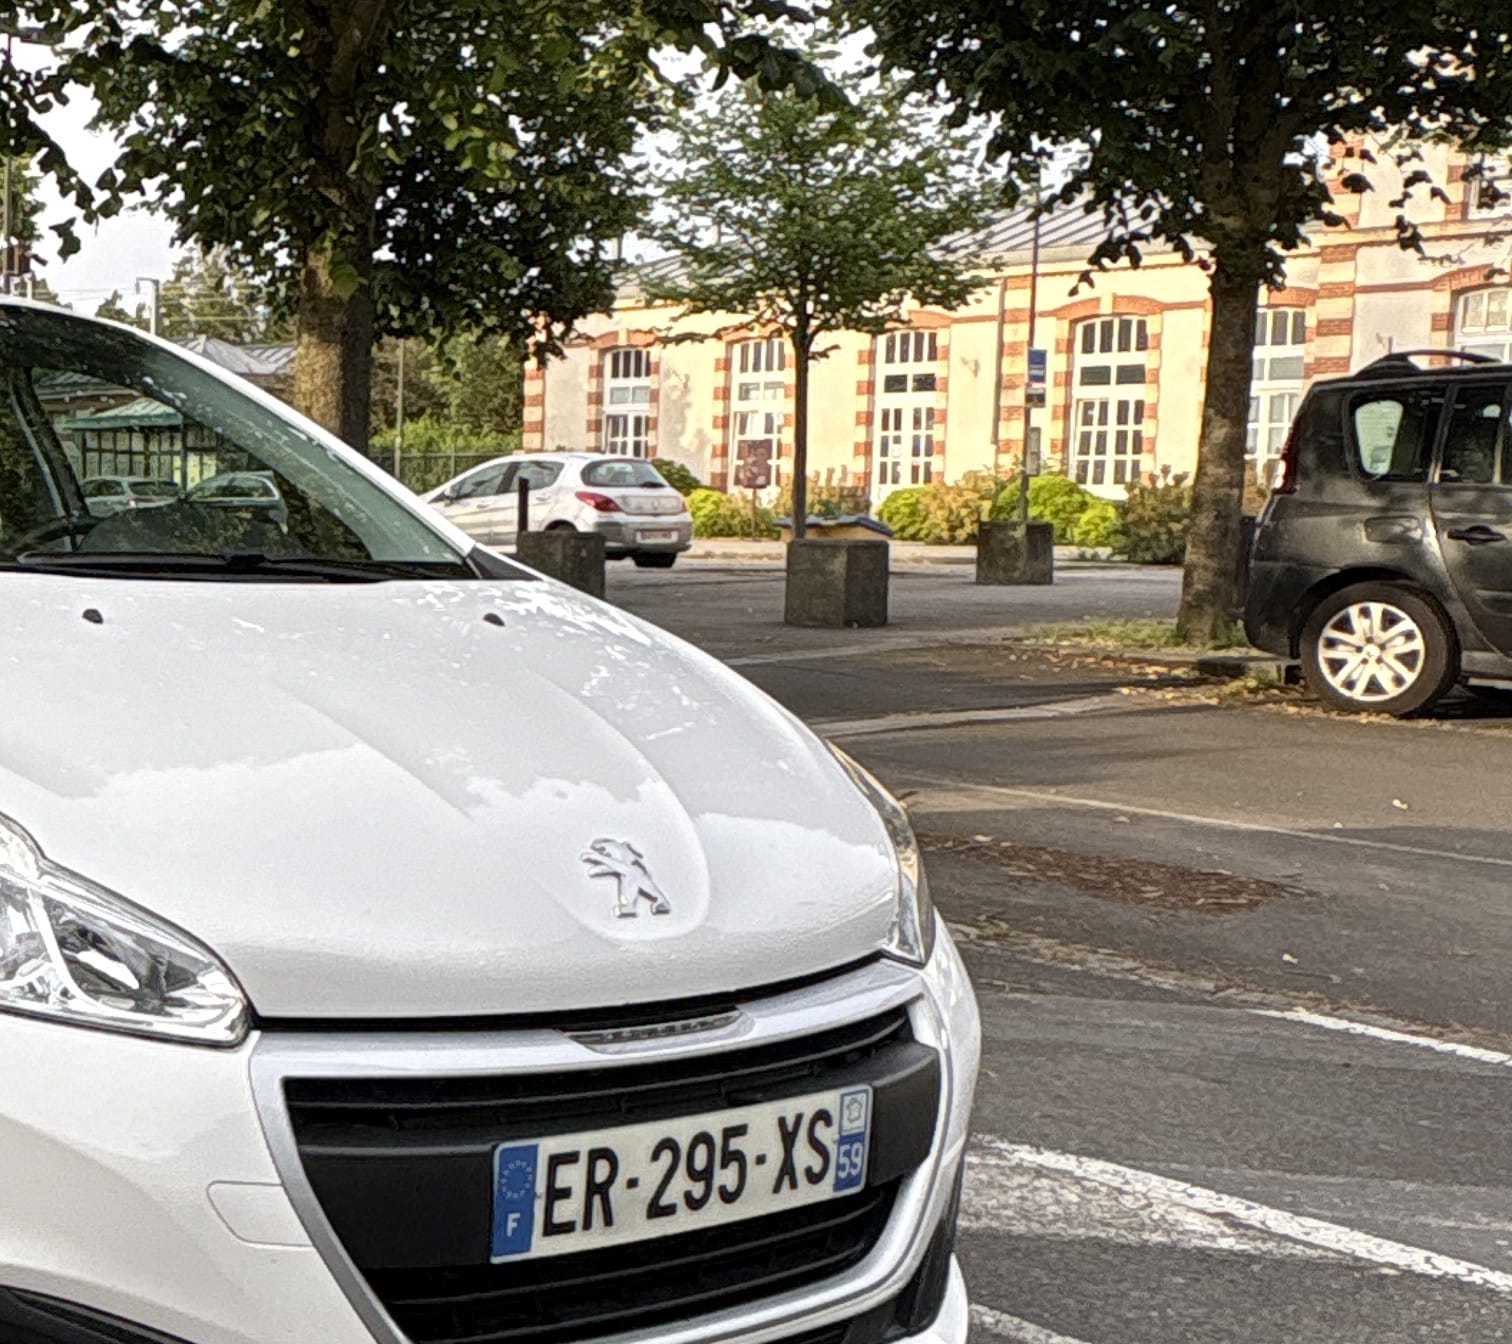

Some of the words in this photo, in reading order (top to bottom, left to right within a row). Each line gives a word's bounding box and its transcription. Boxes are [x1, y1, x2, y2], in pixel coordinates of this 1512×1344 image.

[542, 1108, 833, 1237] ER-295-XS
[837, 1141, 864, 1179] 59
[506, 1213, 521, 1238] F
